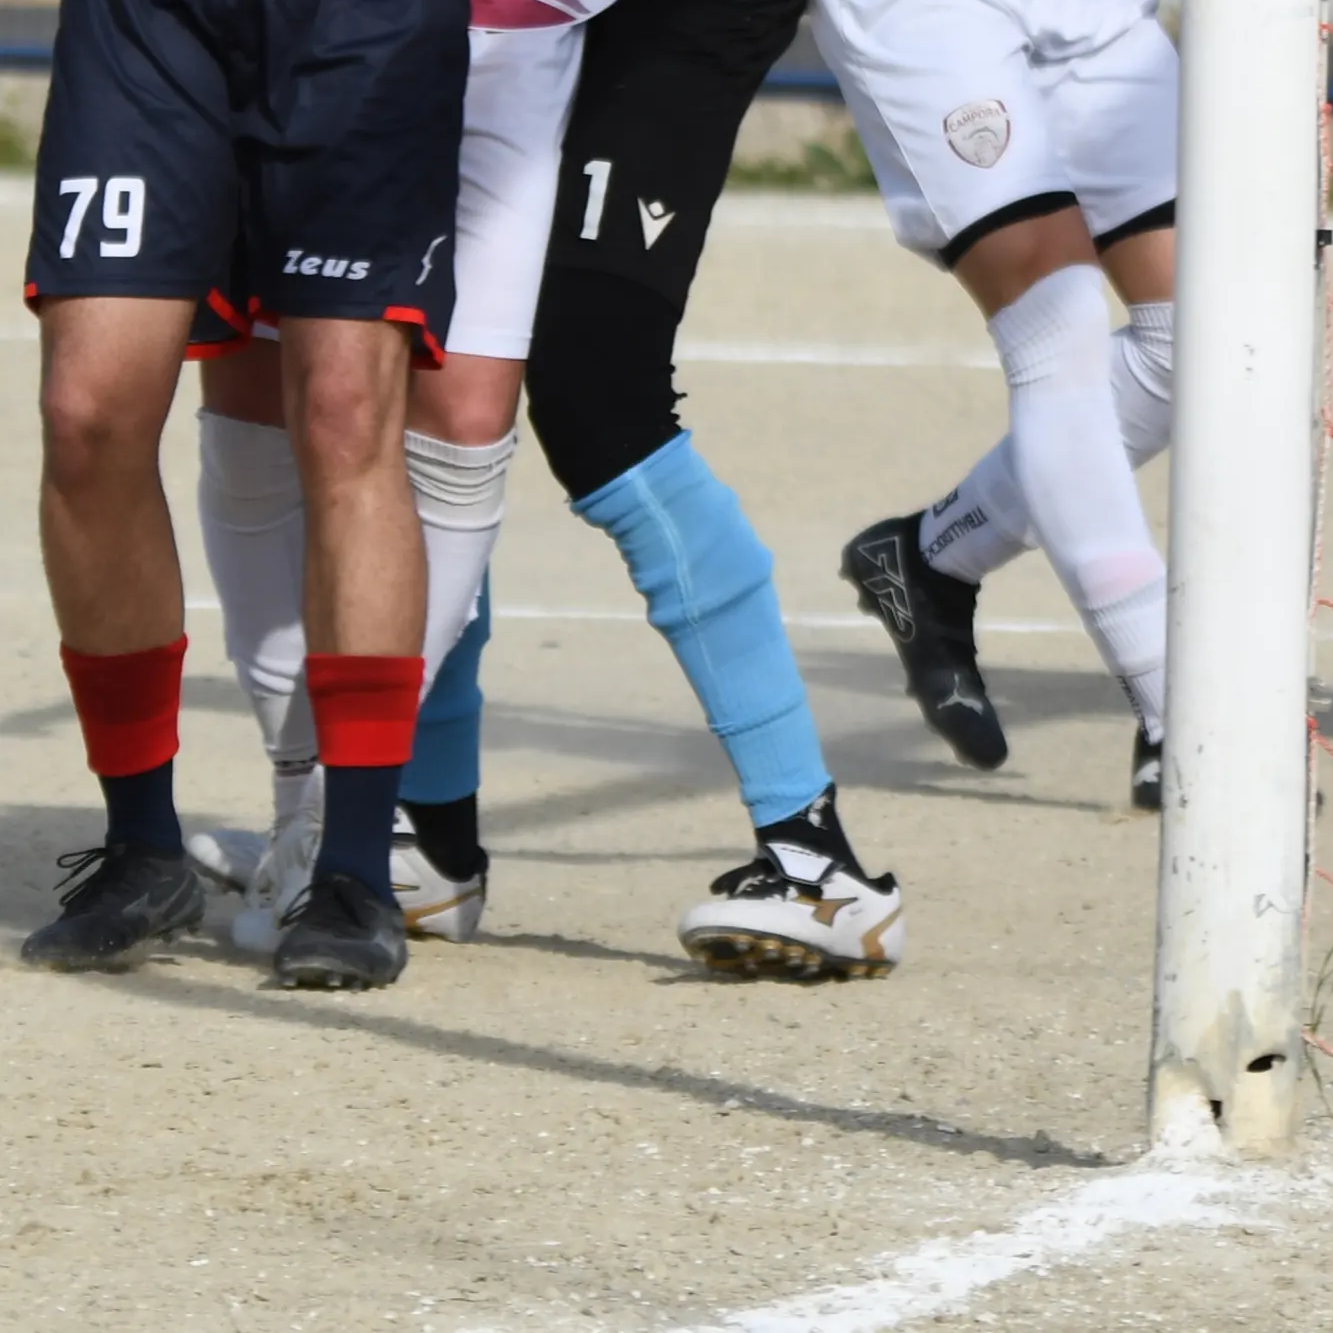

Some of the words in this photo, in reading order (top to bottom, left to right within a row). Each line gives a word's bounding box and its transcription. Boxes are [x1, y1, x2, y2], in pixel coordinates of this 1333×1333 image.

[59, 178, 146, 259] 79
[580, 160, 612, 240] 1
[282, 249, 371, 280] Zeus
